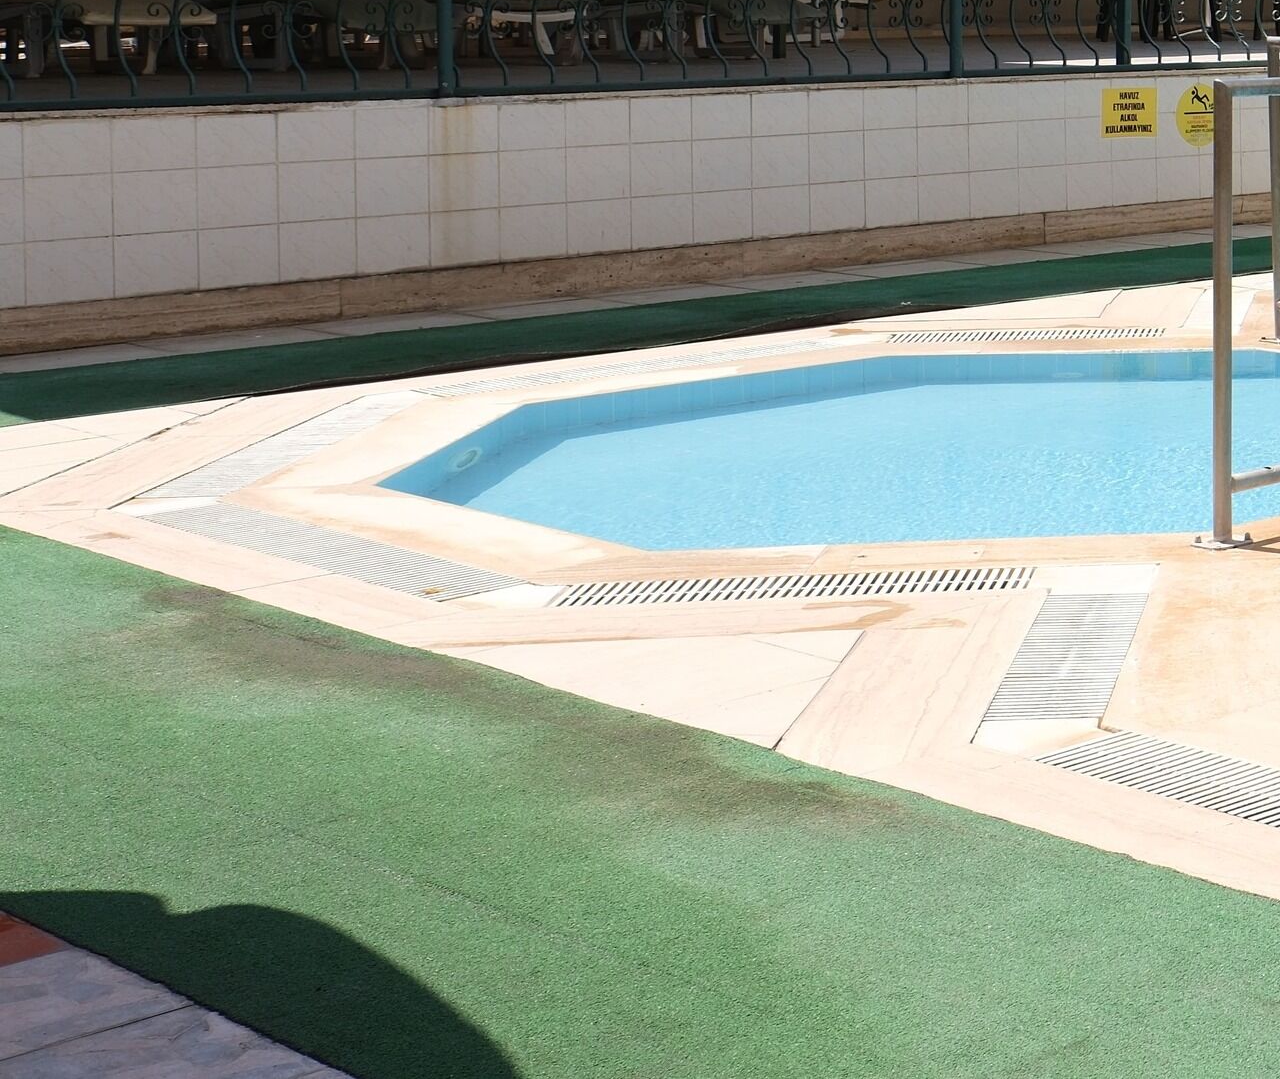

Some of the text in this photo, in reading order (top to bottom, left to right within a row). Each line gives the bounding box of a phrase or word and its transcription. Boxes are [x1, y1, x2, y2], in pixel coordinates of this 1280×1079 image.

[1119, 92, 1139, 100] HAVUZ
[1113, 102, 1145, 111] ETRAFINDA
[1120, 113, 1138, 122] ALKOL
[1105, 124, 1152, 134] KULLANMAYINIZ
